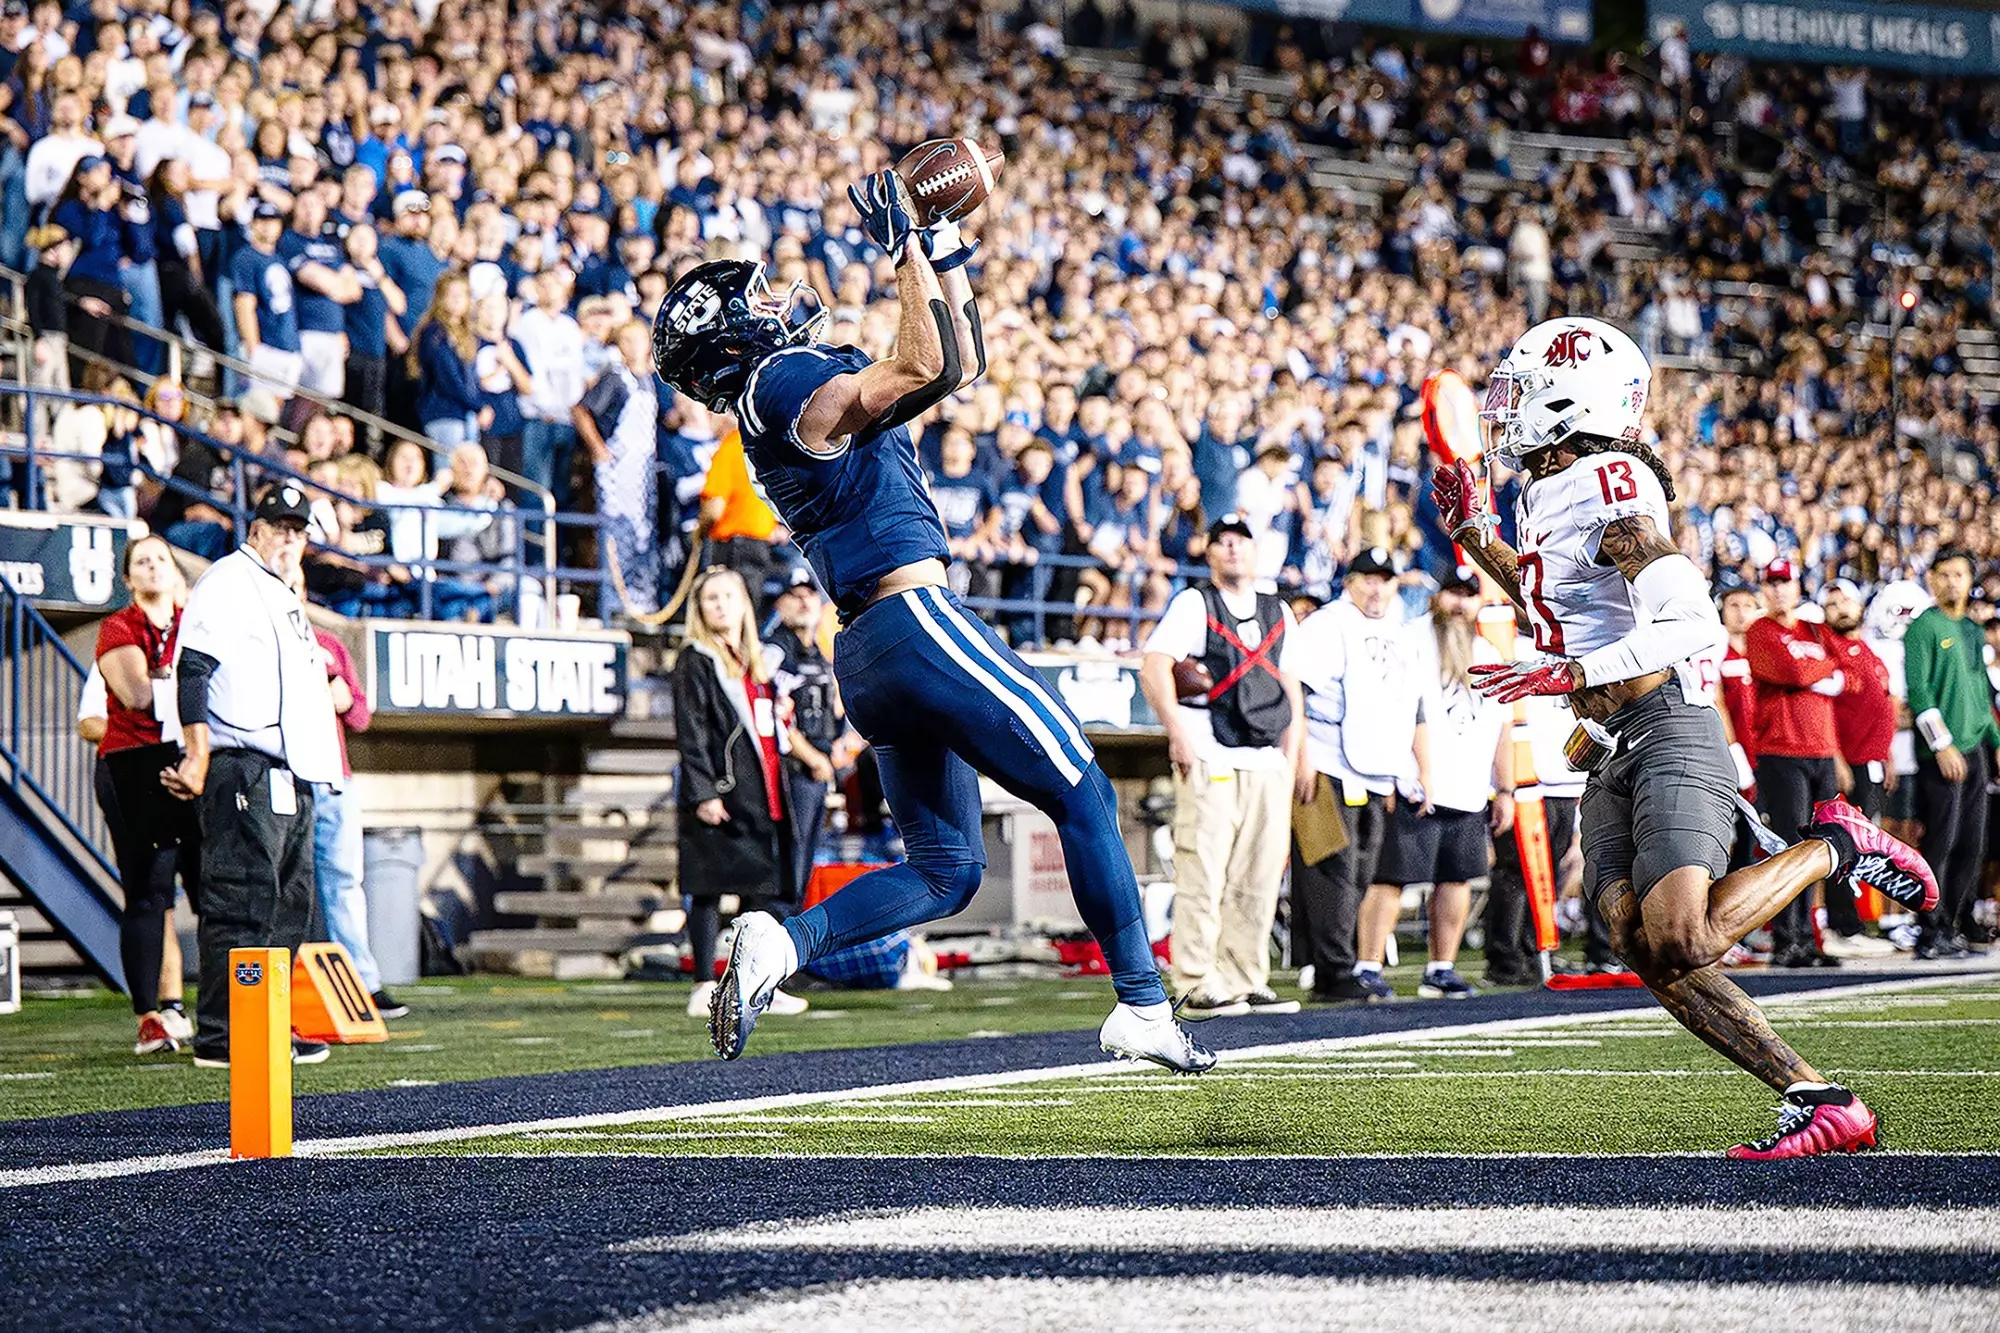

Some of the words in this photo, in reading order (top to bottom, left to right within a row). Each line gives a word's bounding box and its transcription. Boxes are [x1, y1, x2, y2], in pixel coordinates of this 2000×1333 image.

[1742, 5, 1868, 49] BEEHIVE
[1871, 16, 1968, 58] MEALS
[674, 284, 718, 333] STATE
[1594, 460, 1638, 506] 13
[388, 631, 496, 710] UTAH
[505, 637, 619, 714] STATE
[315, 952, 374, 1022] 10
